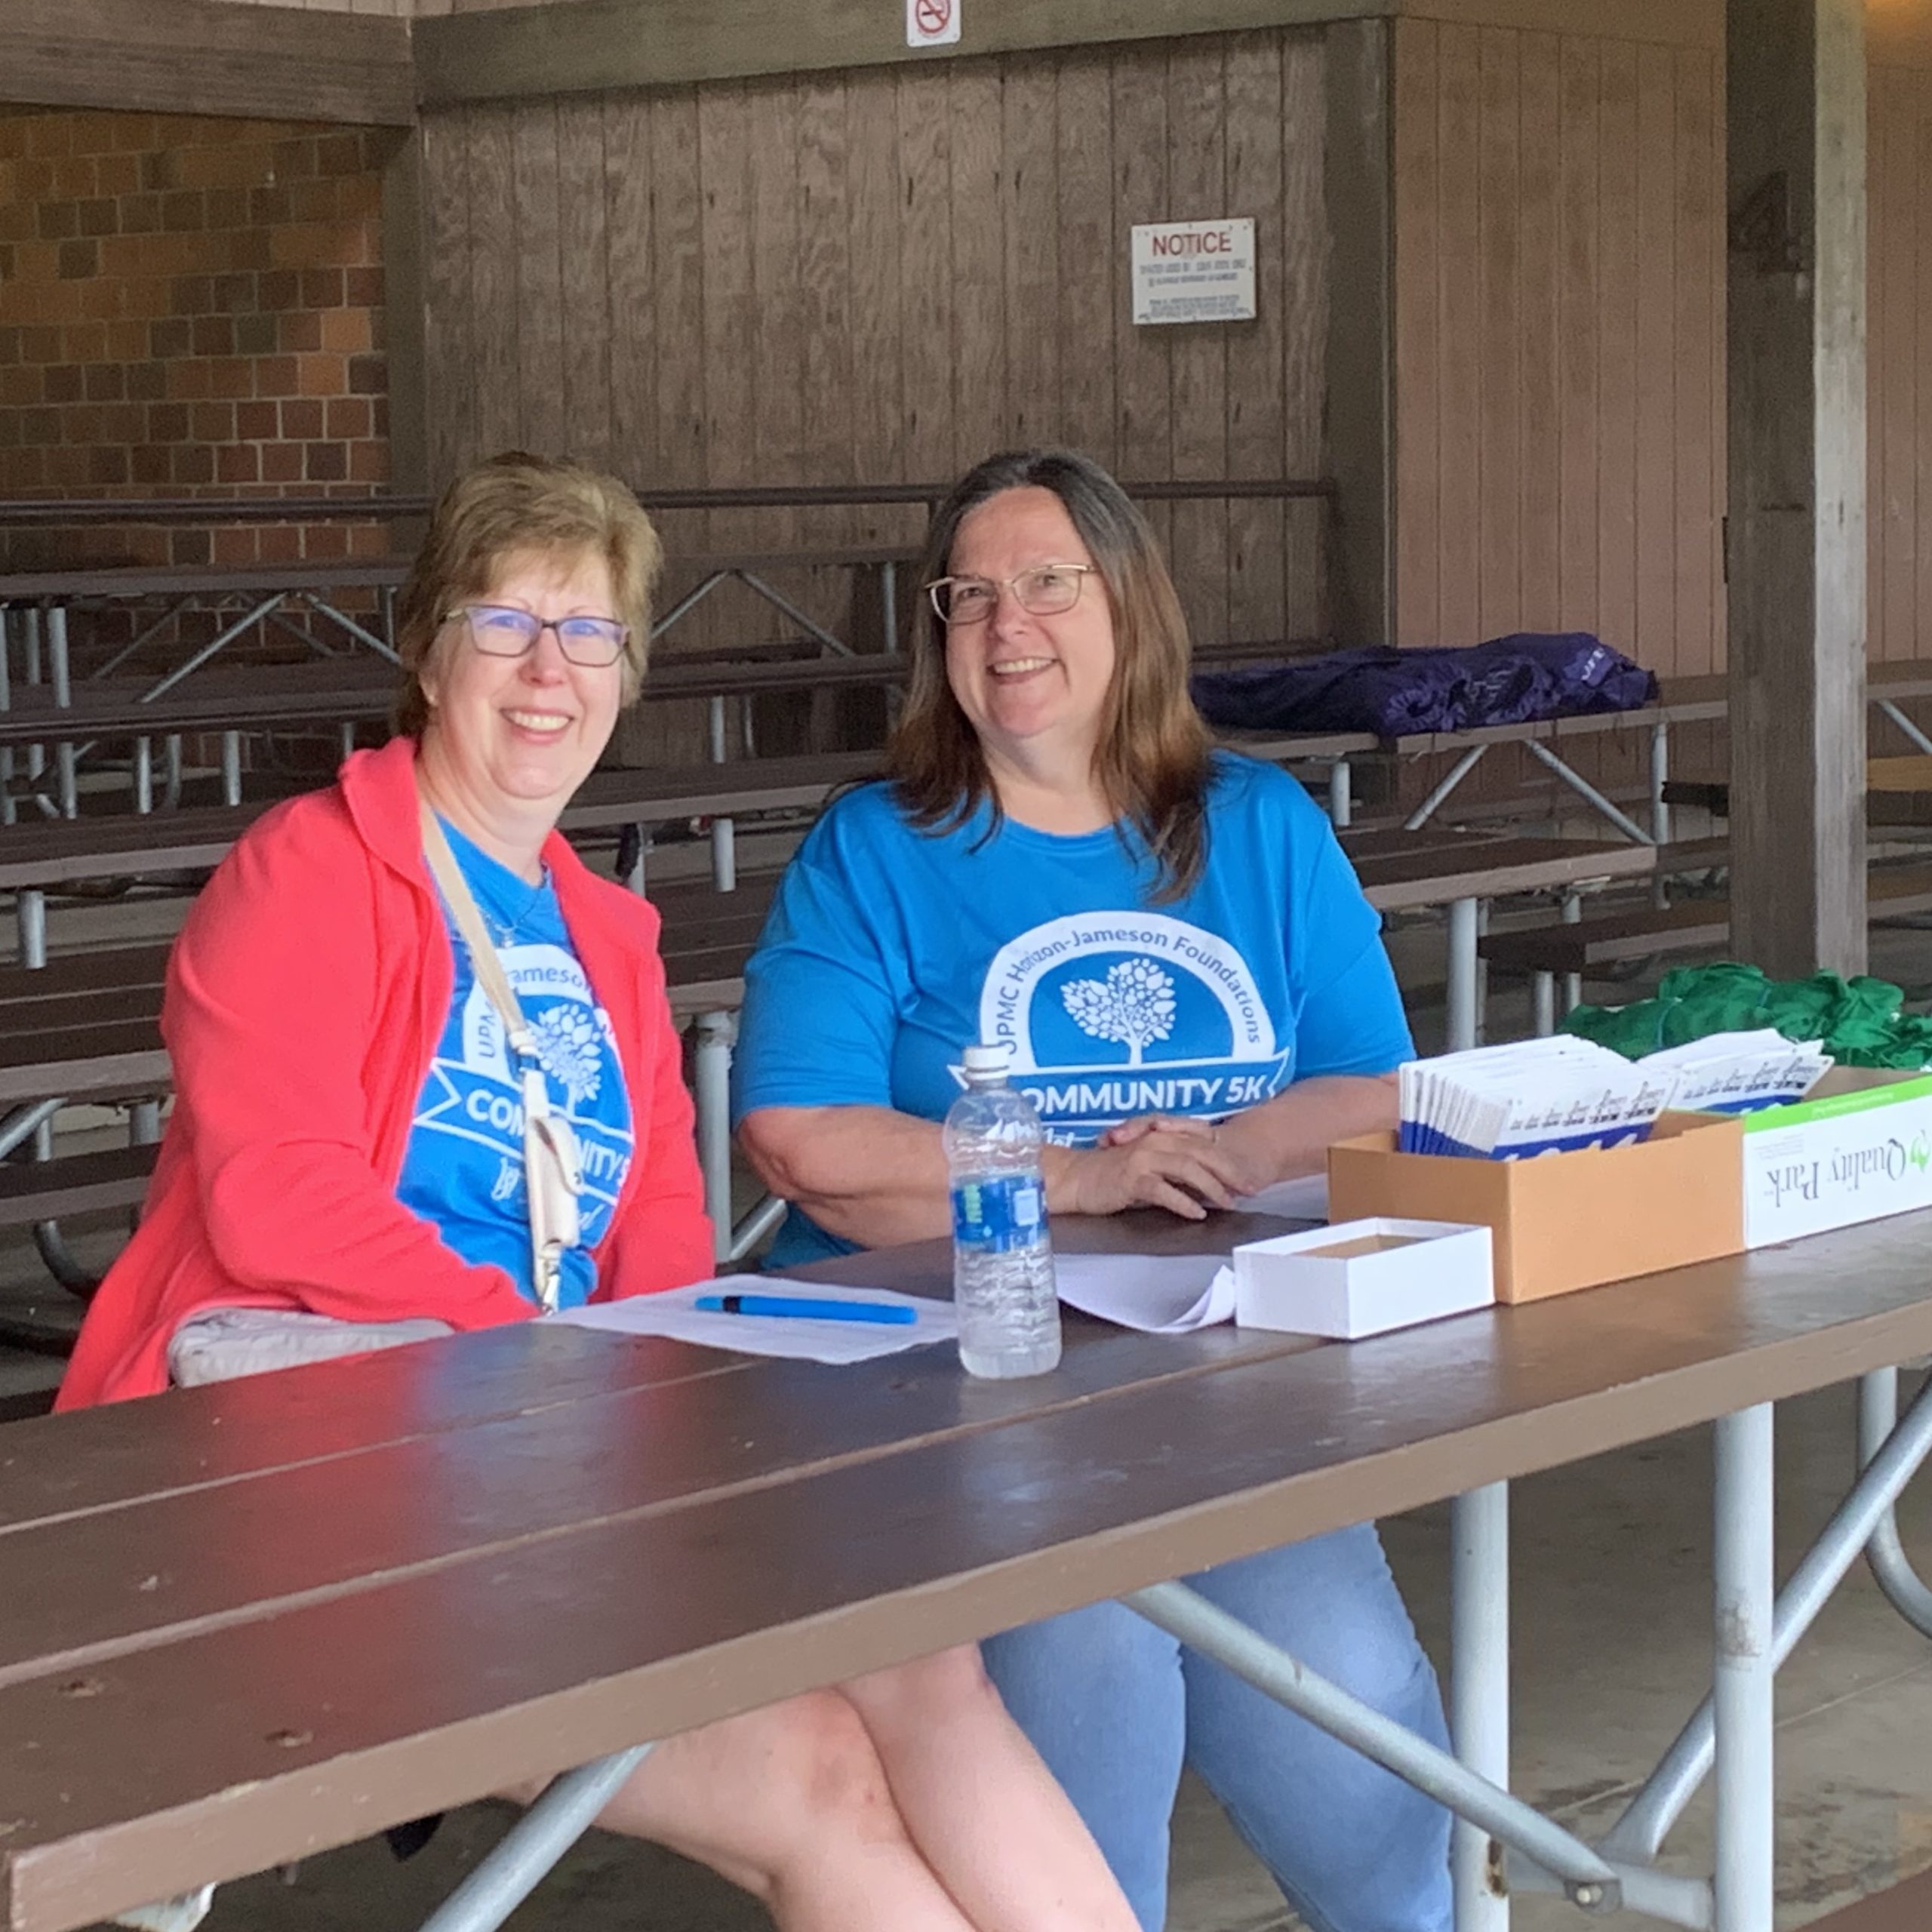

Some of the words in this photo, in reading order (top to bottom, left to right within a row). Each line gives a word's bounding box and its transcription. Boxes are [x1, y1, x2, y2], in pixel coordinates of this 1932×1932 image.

[1152, 232, 1232, 256] NOTICE
[1006, 929, 1168, 983] Horizon-Jameson
[1172, 936, 1261, 1044] Foundations
[1020, 1078, 1223, 1114] OMMUNITY
[1225, 1075, 1267, 1103] 5K
[1767, 1161, 1819, 1208] Park
[1831, 1137, 1906, 1191] Quality
